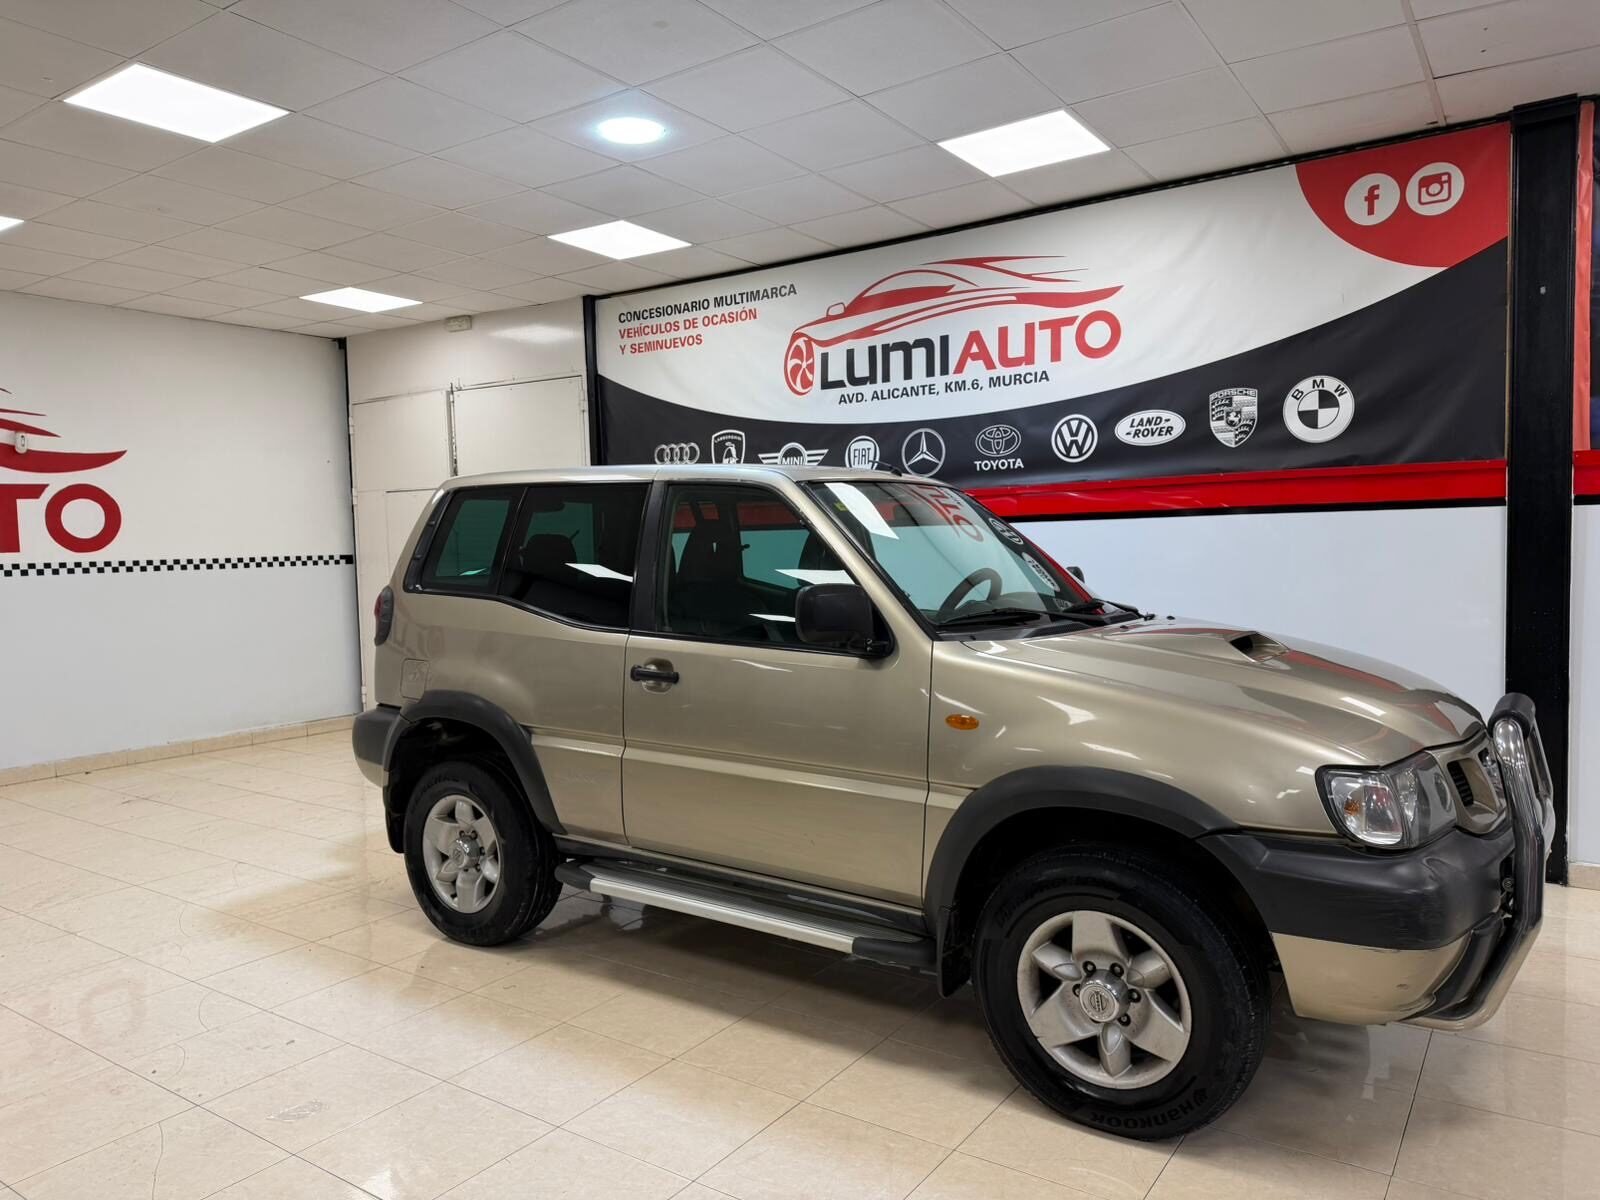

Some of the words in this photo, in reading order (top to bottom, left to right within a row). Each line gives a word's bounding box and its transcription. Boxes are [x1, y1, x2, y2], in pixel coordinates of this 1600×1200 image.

[618, 298, 710, 324] CONCESIONARIO
[713, 283, 797, 309] MULTIMARCA
[618, 320, 680, 340] VEHÍCULOS
[683, 317, 699, 330] DE
[702, 307, 758, 328] OCASIÓN
[619, 344, 627, 355] Y
[630, 333, 703, 354] SEMINUEVOS
[838, 393, 868, 406] AVD.
[870, 383, 940, 402] ALICANTE,
[988, 370, 1050, 389] MURCIA
[1291, 378, 1347, 401] BMW
[853, 447, 872, 466] FIAT
[974, 457, 1024, 471] TOYOTA
